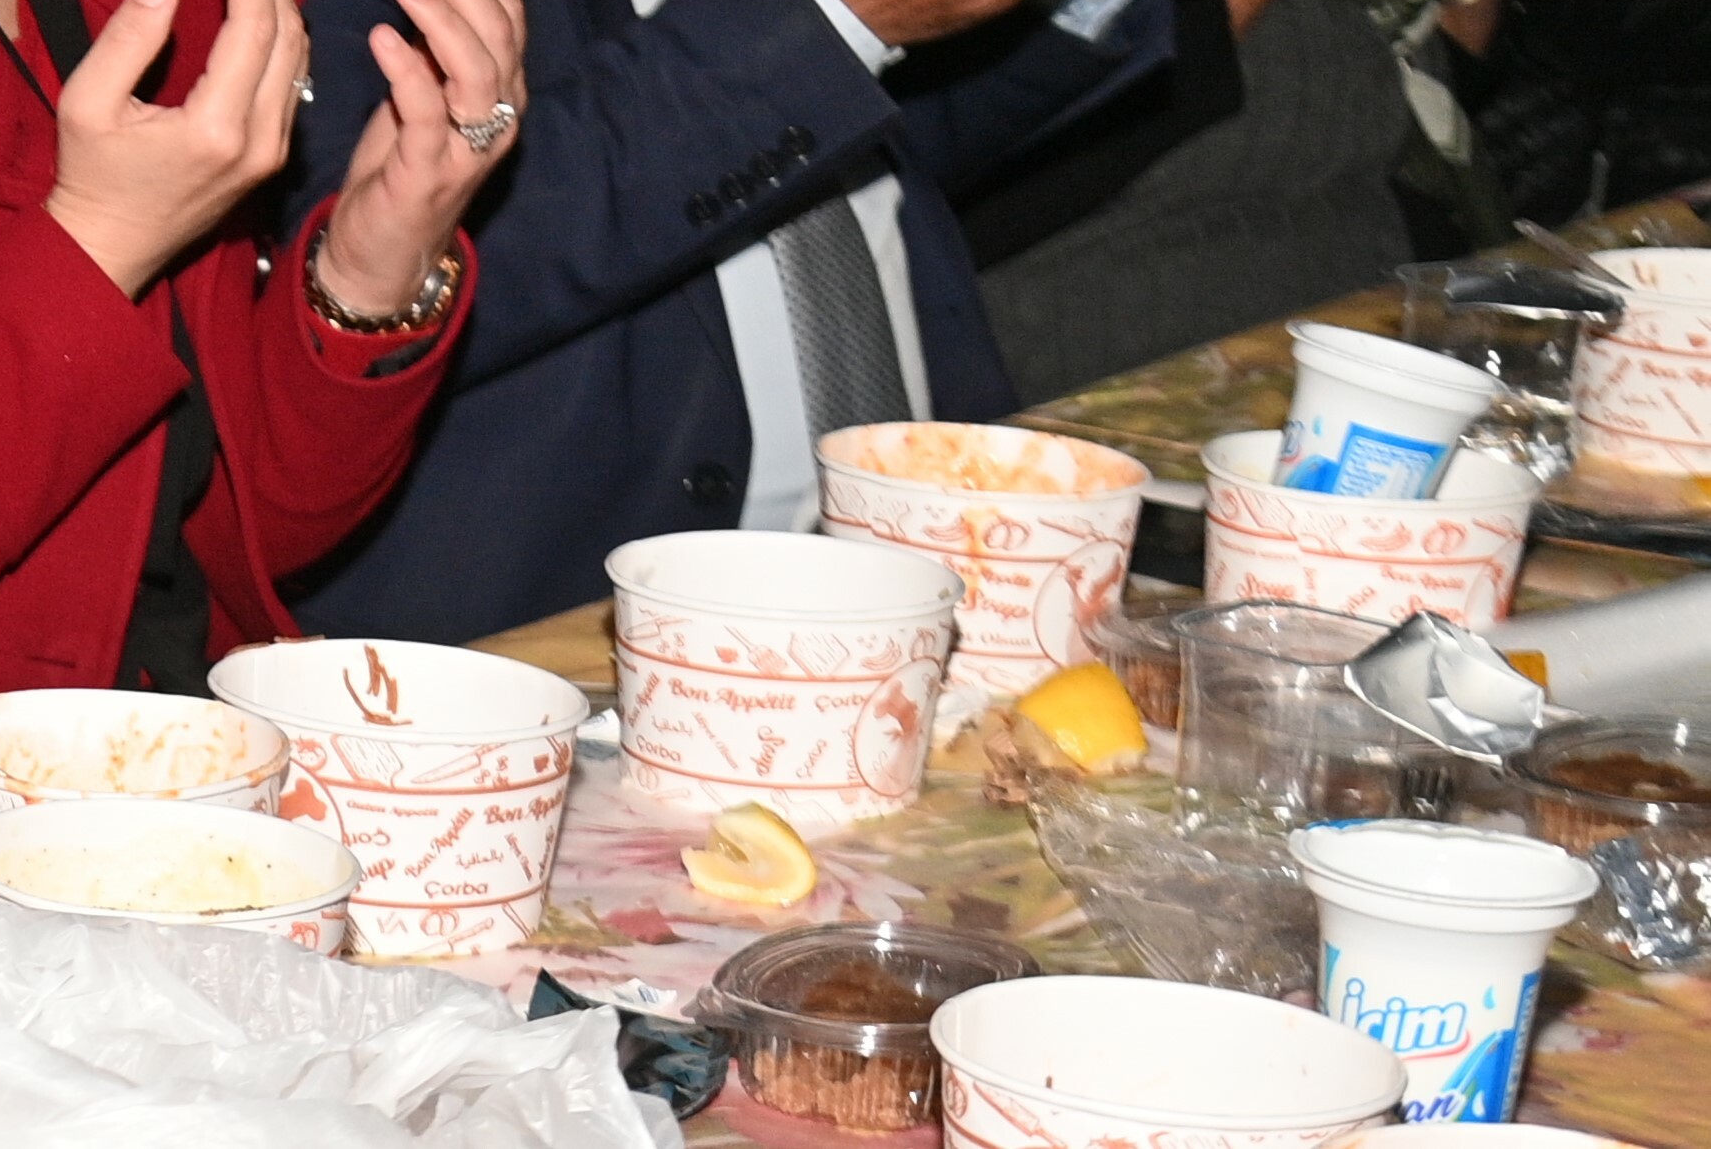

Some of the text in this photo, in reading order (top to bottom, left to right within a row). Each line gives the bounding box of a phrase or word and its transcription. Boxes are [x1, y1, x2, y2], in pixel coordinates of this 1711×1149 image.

[668, 677, 711, 703] Bon
[635, 734, 682, 764] Çorba
[484, 804, 525, 826] Bon
[404, 851, 438, 878] Bon
[423, 880, 489, 899] Çorba
